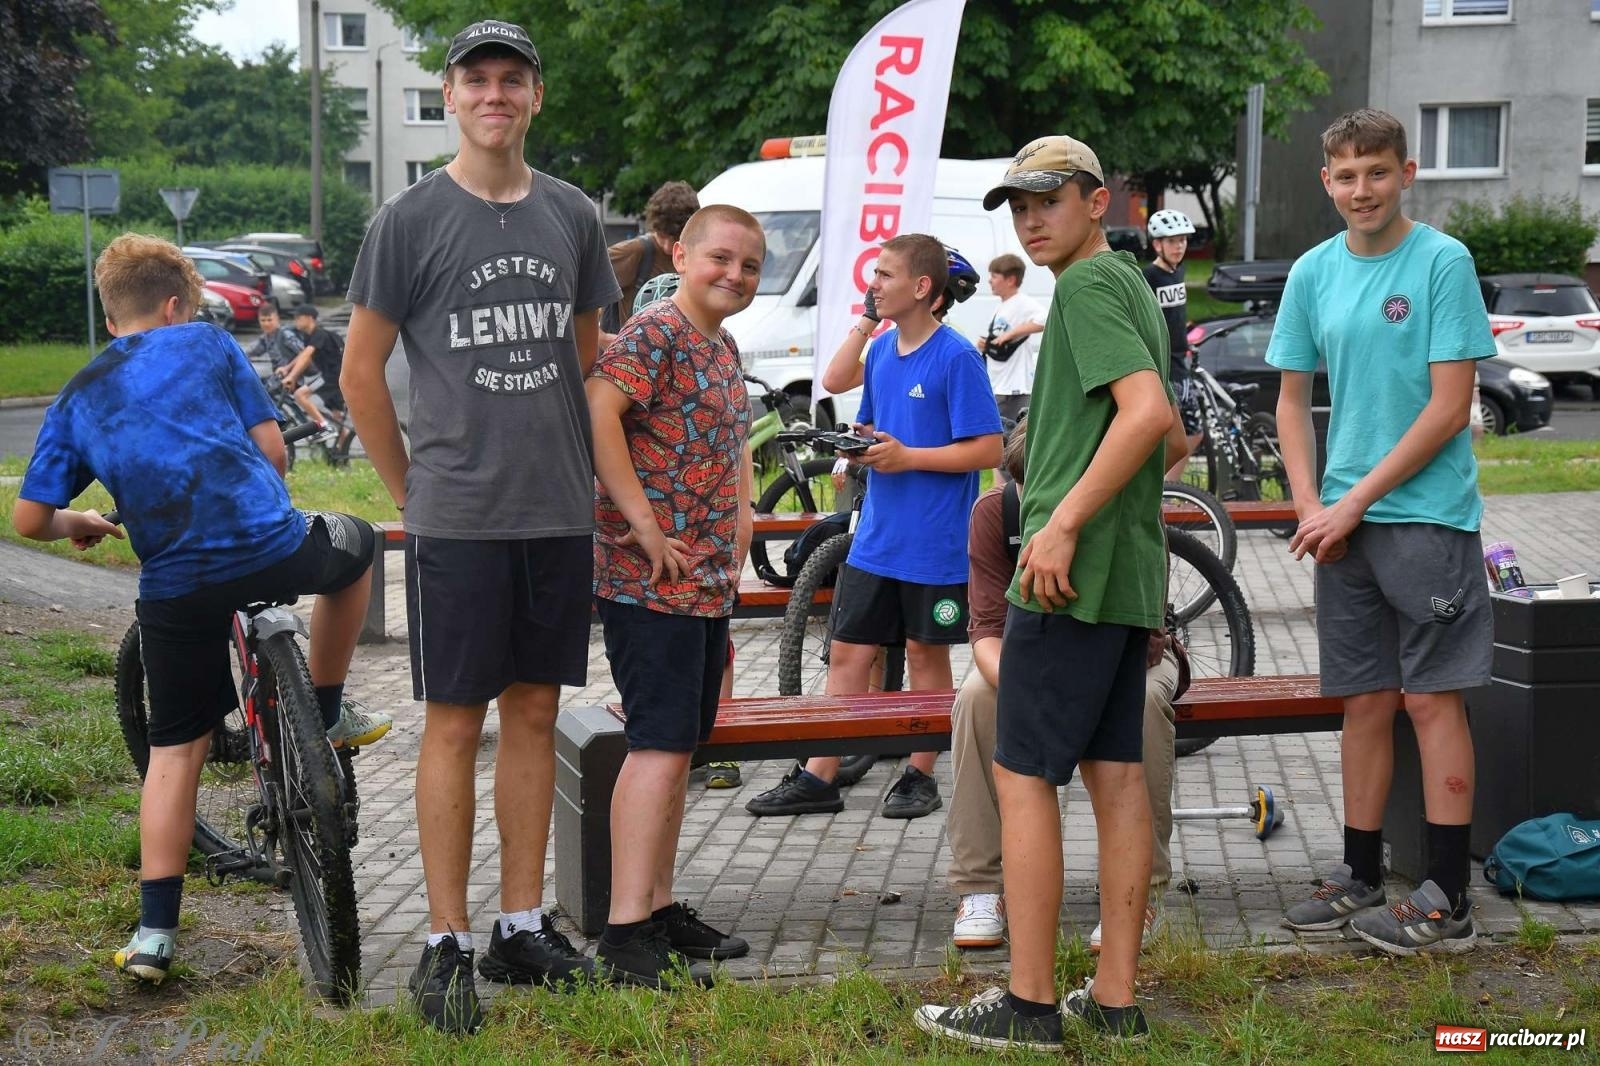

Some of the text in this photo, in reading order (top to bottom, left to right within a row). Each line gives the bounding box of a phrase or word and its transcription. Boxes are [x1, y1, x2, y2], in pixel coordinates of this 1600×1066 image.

[466, 26, 518, 39] ALUKON
[470, 256, 556, 289] JESTEM
[449, 303, 571, 348] LENIWY
[509, 350, 532, 363] ALE
[475, 367, 502, 391] SIĘ
